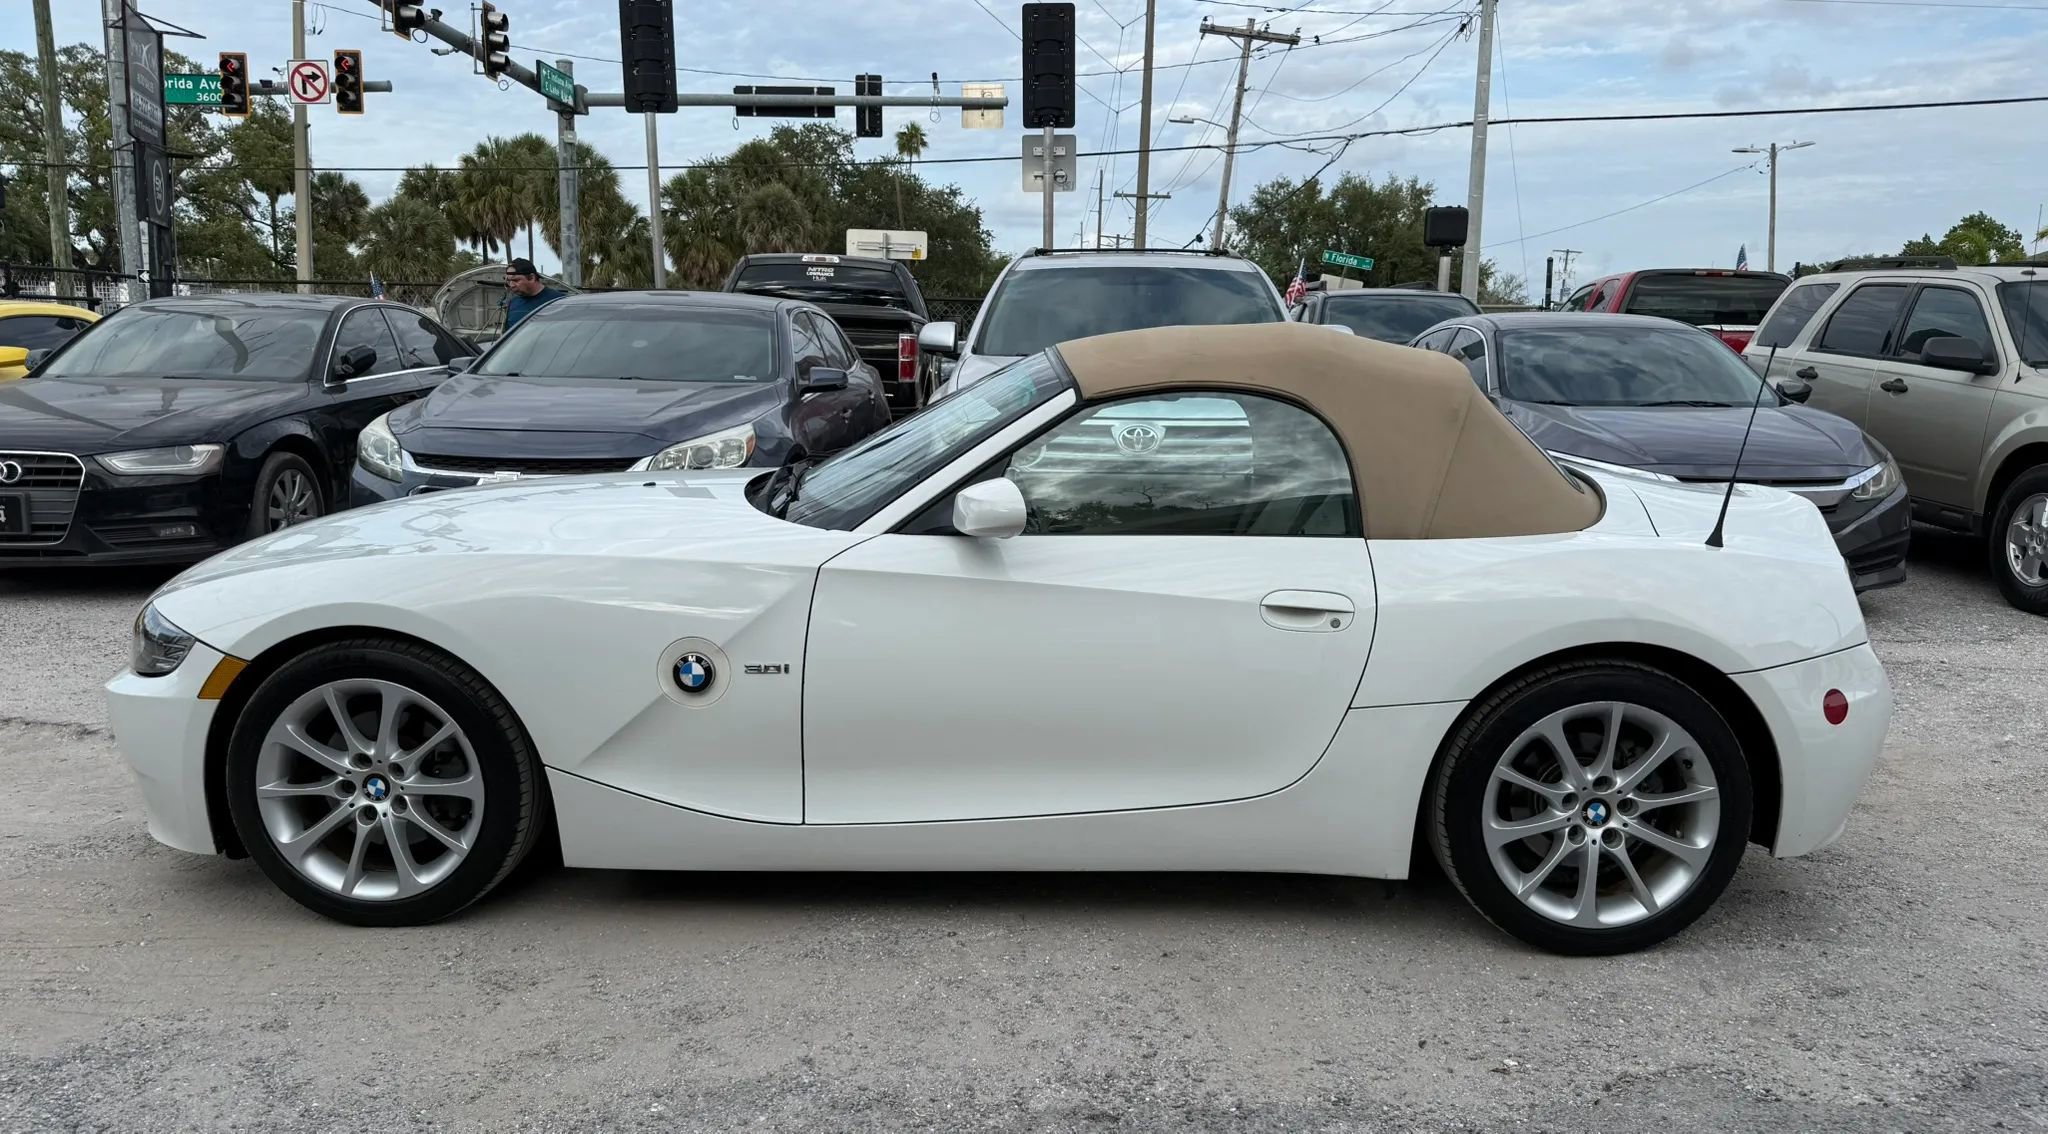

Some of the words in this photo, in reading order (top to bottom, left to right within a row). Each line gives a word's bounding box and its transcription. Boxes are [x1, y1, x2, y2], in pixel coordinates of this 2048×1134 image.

[200, 79, 223, 90] Ave
[196, 93, 223, 102] 3600
[1331, 253, 1358, 266] Florida
